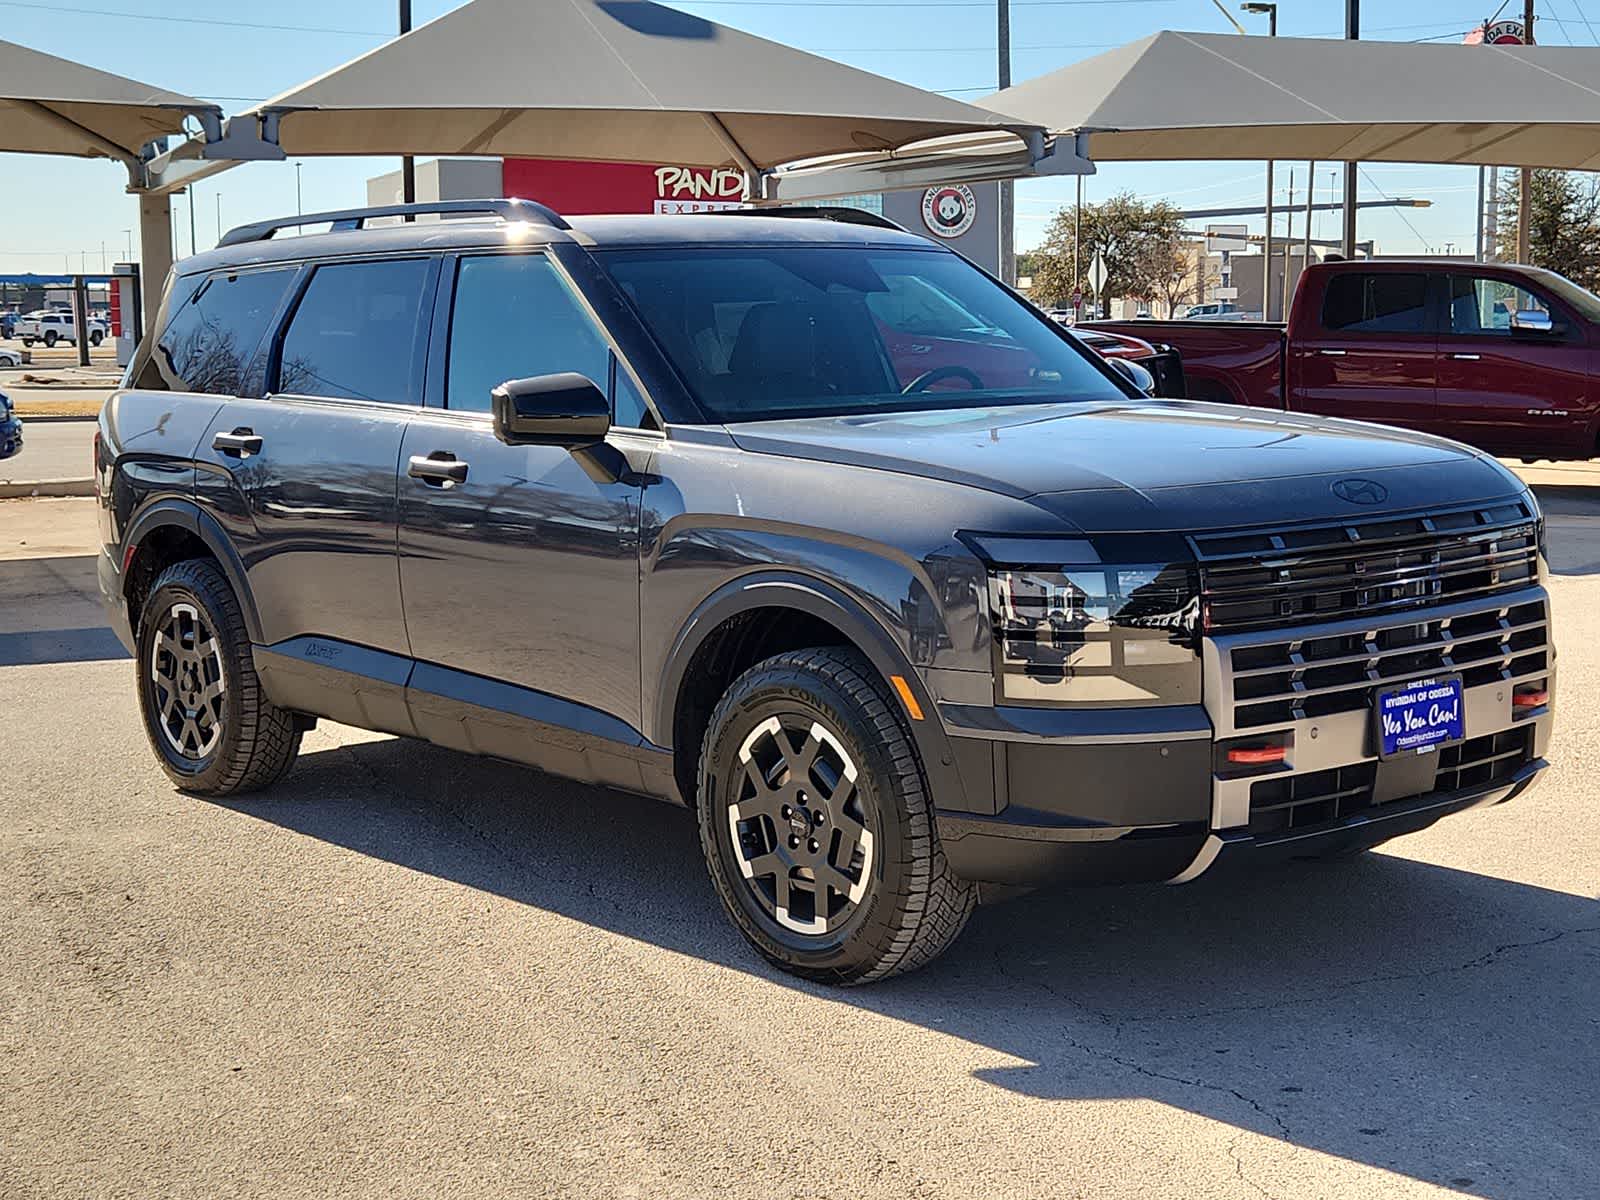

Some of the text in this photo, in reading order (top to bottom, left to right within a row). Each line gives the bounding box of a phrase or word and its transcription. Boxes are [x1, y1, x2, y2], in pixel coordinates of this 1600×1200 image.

[654, 167, 744, 199] PAND
[1385, 686, 1454, 708] HYUNDAI OF ODESSA
[1383, 698, 1458, 736] Yes You Can!
